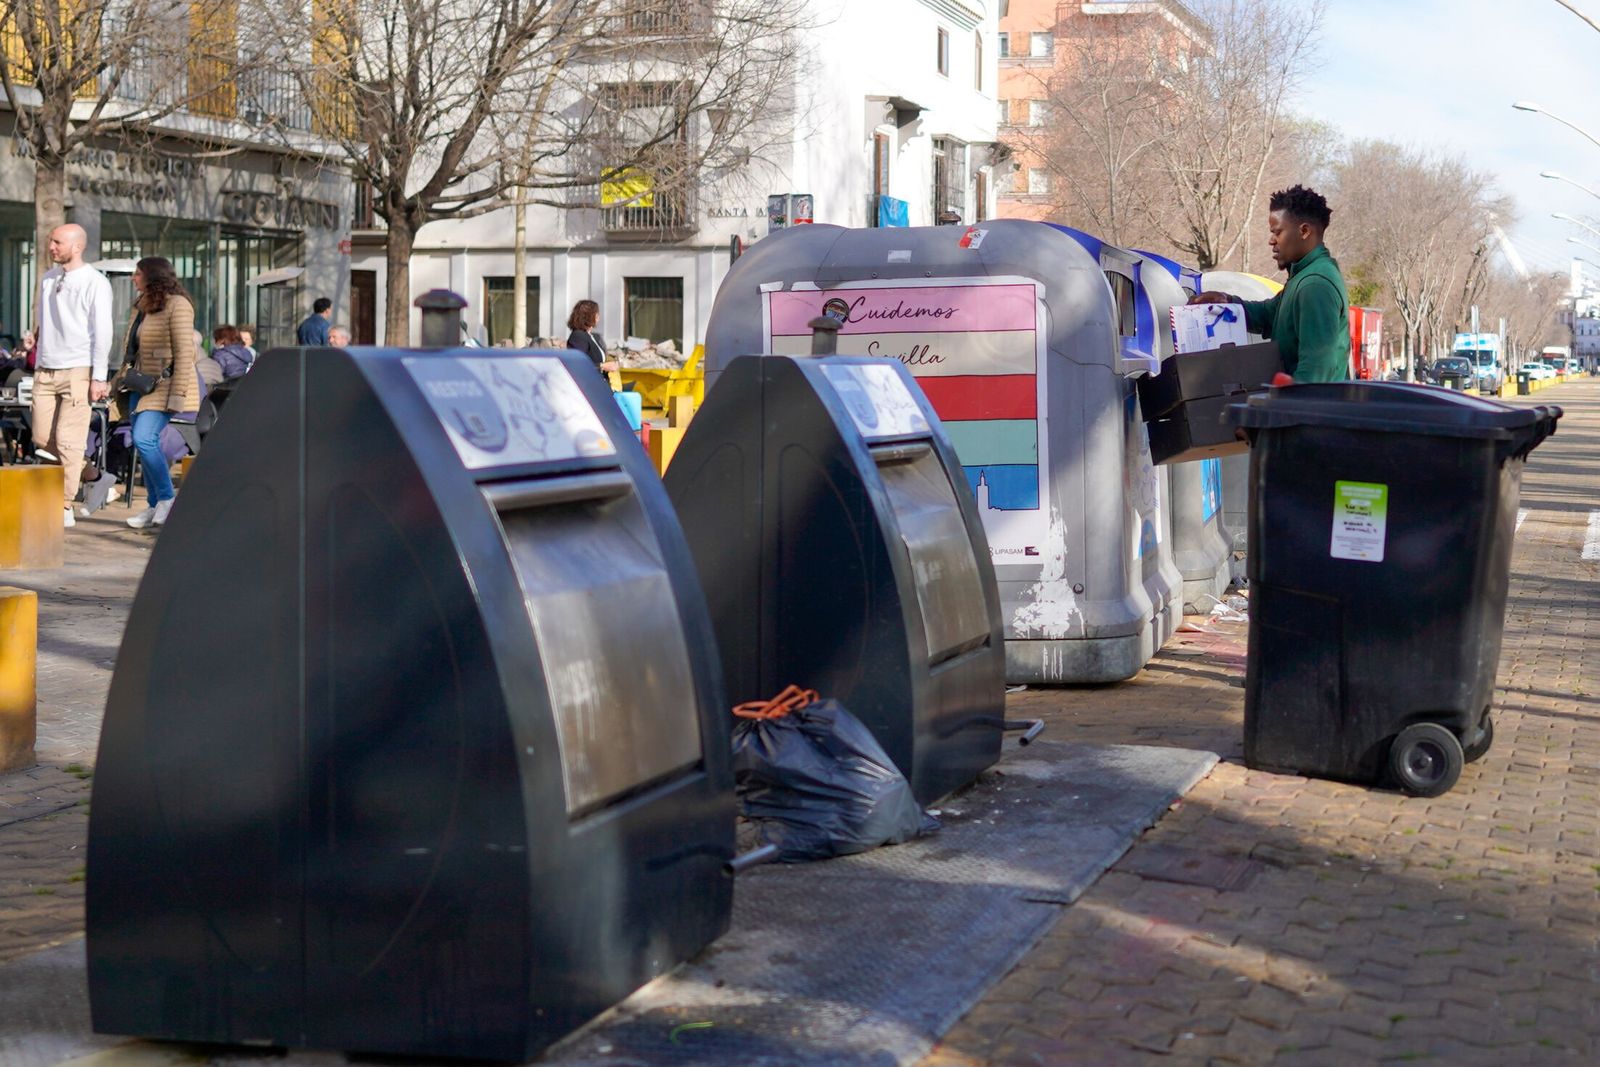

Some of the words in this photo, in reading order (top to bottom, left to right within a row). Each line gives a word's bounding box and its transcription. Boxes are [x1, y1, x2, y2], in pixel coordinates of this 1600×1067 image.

[707, 207, 748, 218] SANTA
[847, 296, 960, 324] Cuidemos
[868, 341, 946, 366] Silla
